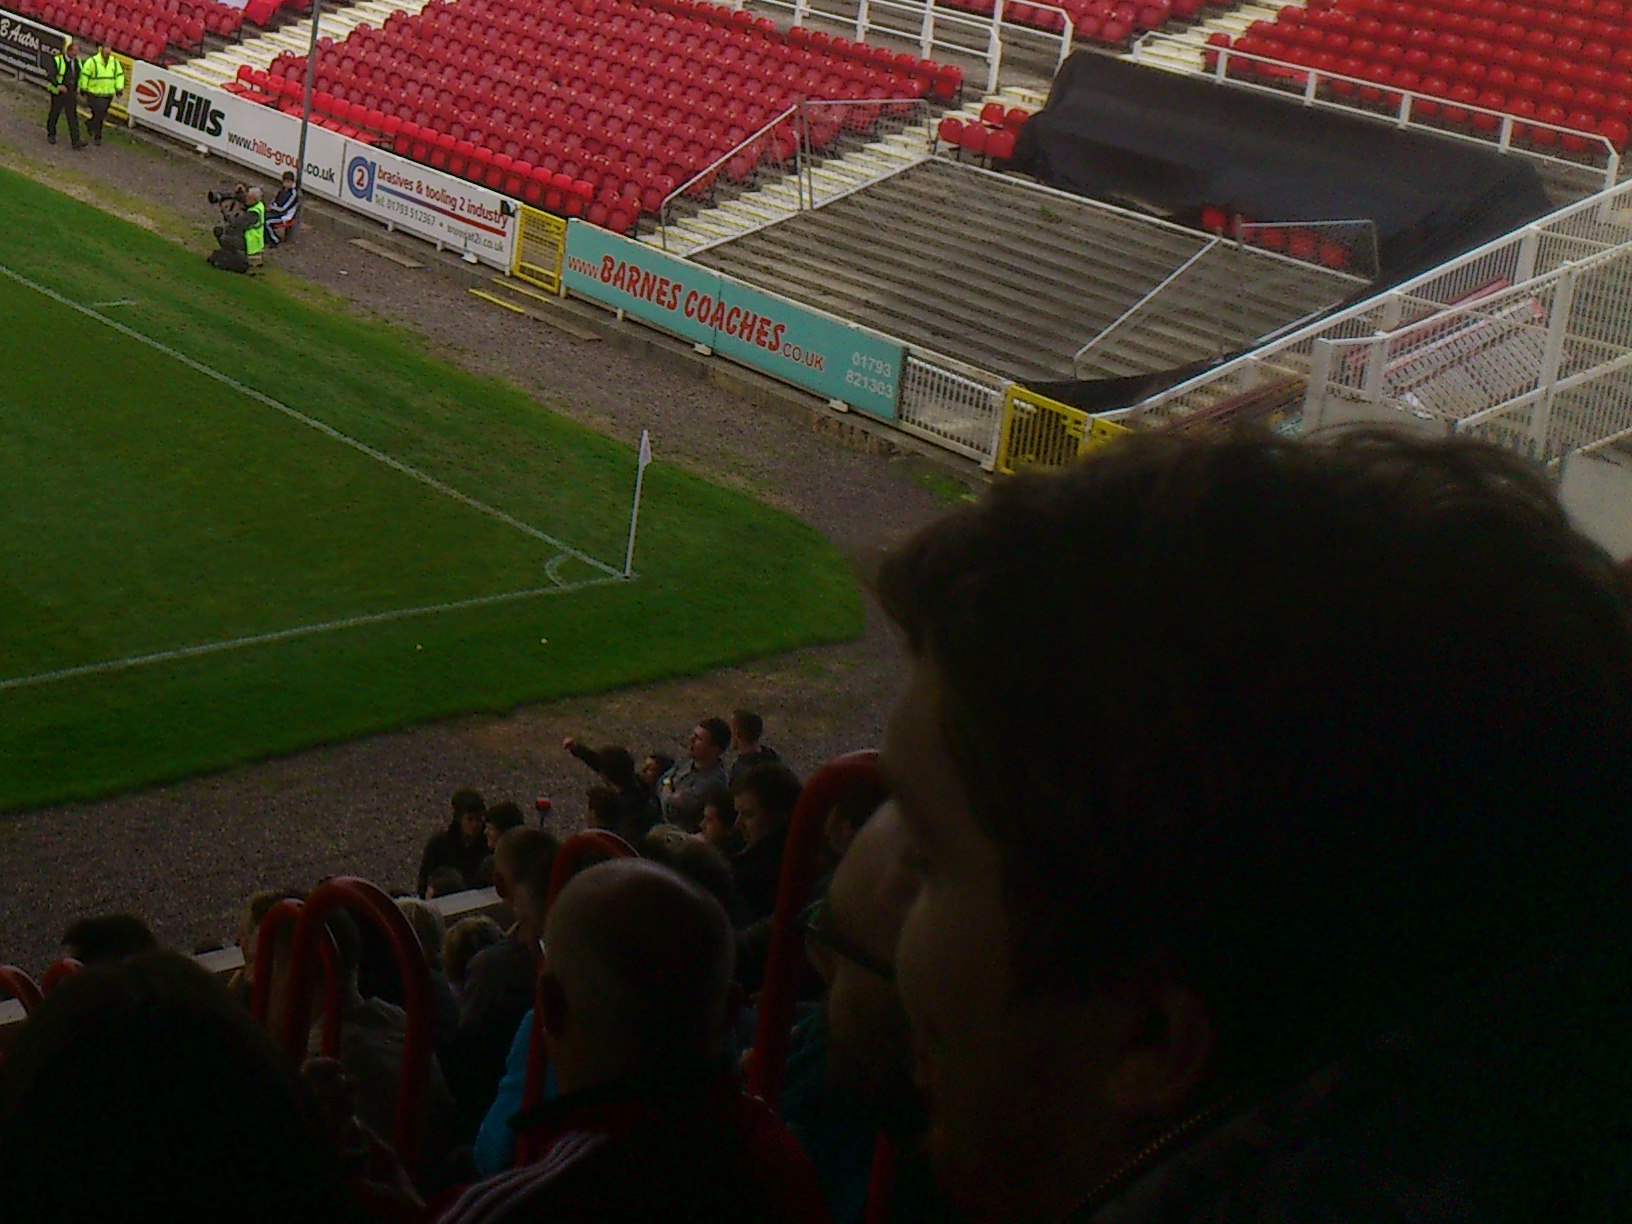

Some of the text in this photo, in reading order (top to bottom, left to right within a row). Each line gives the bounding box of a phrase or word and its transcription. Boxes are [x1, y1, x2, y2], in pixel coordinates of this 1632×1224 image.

[7, 25, 41, 51] Autos
[163, 83, 226, 137] Hills
[227, 130, 336, 184] www.hills-grou.co.uk
[377, 165, 509, 229] brasives & tooling 2 industry
[386, 198, 409, 218] 01793
[851, 351, 892, 378] 01793
[845, 369, 894, 400] 821303
